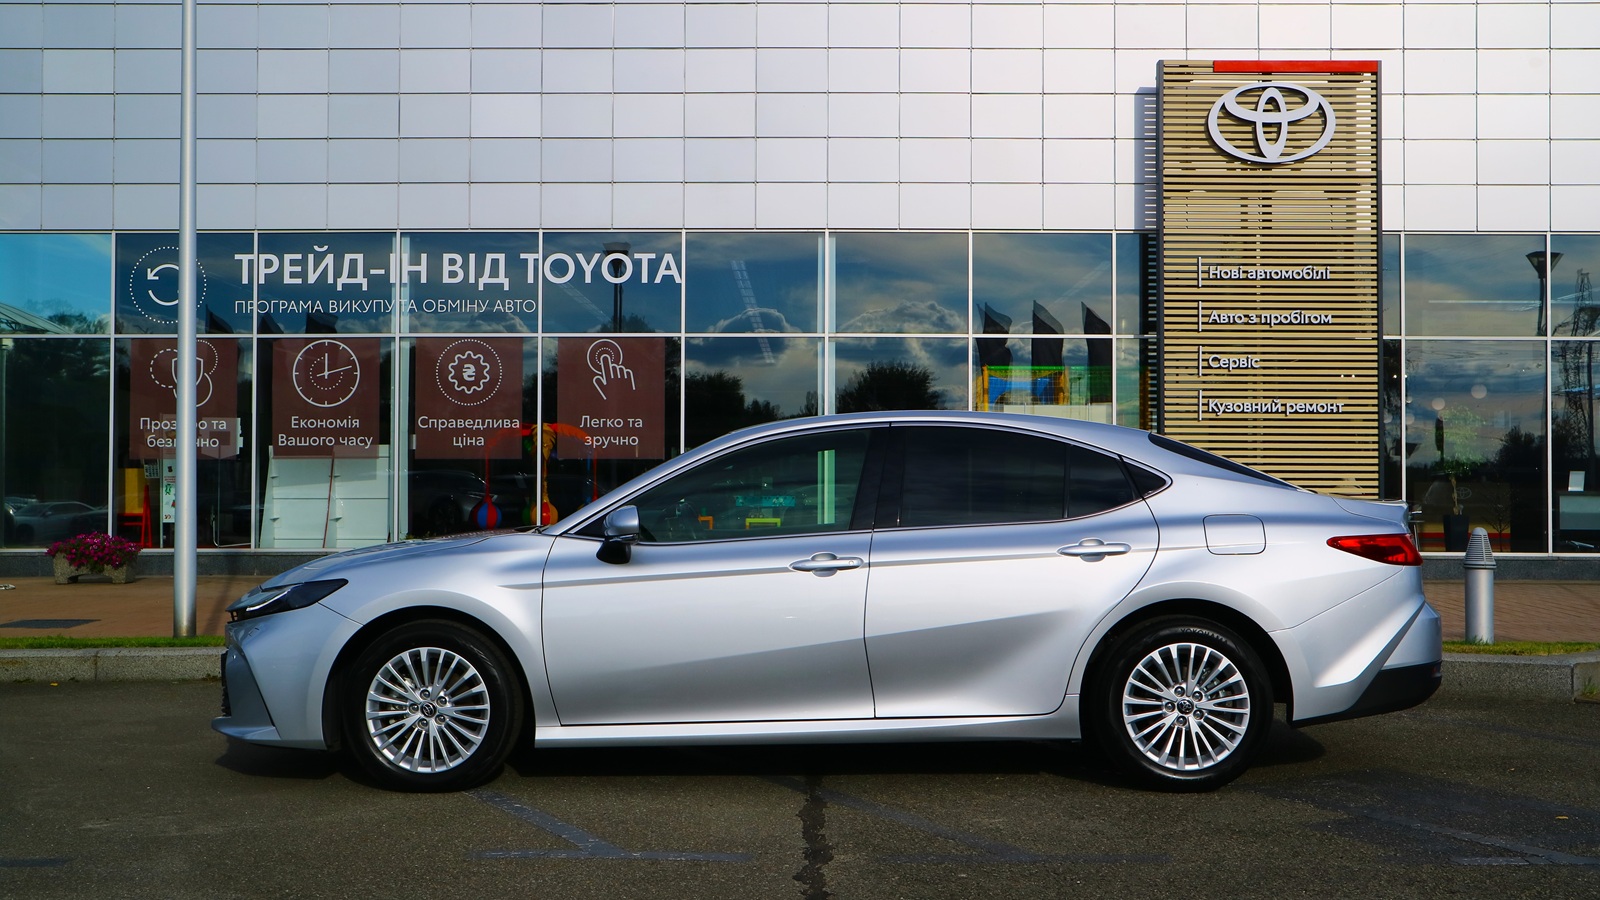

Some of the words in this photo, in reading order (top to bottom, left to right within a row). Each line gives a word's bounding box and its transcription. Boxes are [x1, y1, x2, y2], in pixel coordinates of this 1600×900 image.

[234, 245, 427, 291] ТРЕЙД-ІН
[442, 253, 509, 290] ВІД
[520, 253, 682, 284] TOYOTA
[1208, 265, 1243, 280] Нові
[1247, 265, 1331, 280] автомобілі
[235, 300, 324, 314] ПРОГРАМА
[329, 300, 396, 313] ВИКУПУ
[398, 299, 418, 313] ТА
[422, 299, 489, 313] ОБМІНУ
[493, 299, 536, 313] АВТО
[1208, 310, 1244, 324] Авто
[1248, 314, 1257, 324] з
[1261, 310, 1333, 327] пробігом
[1208, 355, 1261, 370] Сервіс
[1208, 399, 1282, 416] Кузовний
[1286, 402, 1345, 416] ремонт
[140, 417, 208, 433] Прозо
[211, 420, 227, 430] та
[291, 416, 360, 428] Економія
[417, 416, 520, 431] Справедлива
[580, 415, 623, 428] Легко
[627, 418, 643, 428] та
[278, 434, 335, 446] Вашого
[339, 437, 373, 449] часу
[453, 434, 485, 448] ціна
[584, 436, 639, 448] зручно
